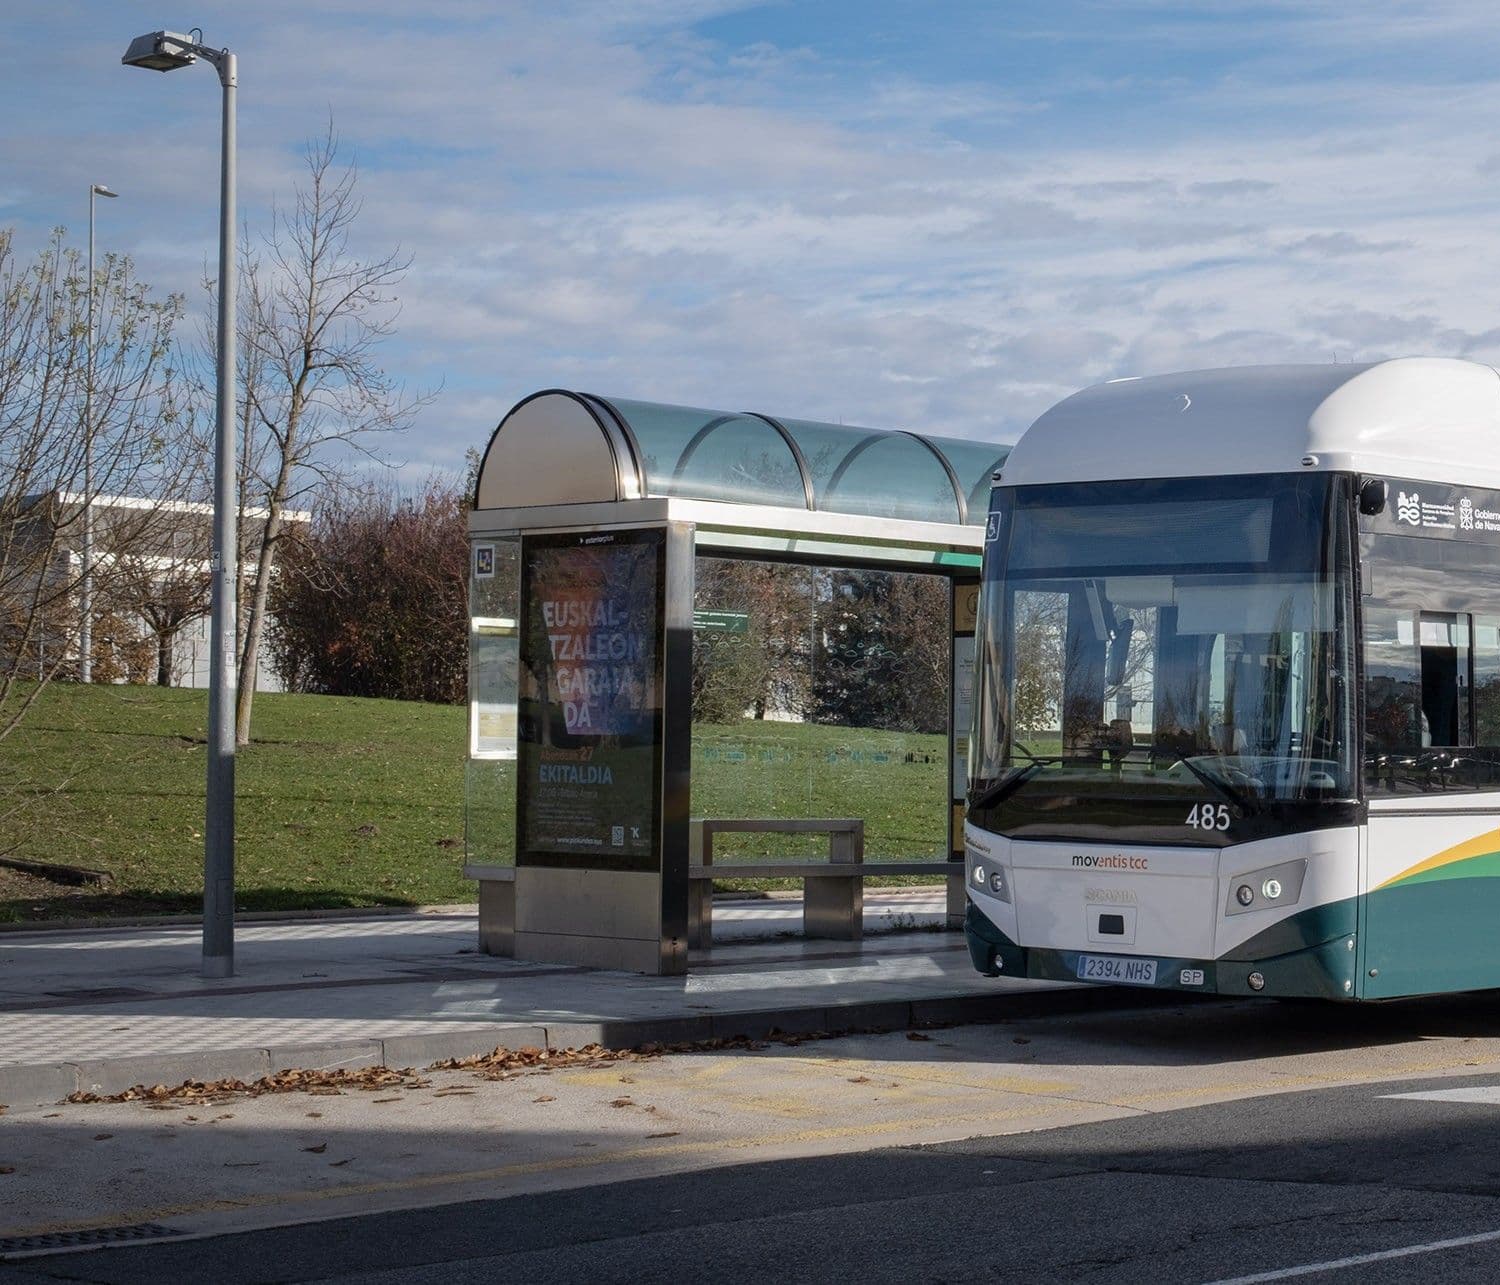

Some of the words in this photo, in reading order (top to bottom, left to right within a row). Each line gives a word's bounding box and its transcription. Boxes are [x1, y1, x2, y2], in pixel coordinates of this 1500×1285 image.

[1475, 521, 1484, 529] de
[543, 600, 629, 627] EUSKAL-
[549, 632, 643, 660] TZALEON
[564, 701, 592, 728] DA
[539, 764, 614, 784] EKITALDIA
[1185, 803, 1230, 830] 485
[1072, 854, 1128, 869] moventis
[1129, 857, 1148, 870] tcc
[1087, 960, 1121, 977] 2394
[1125, 962, 1152, 980] NHS
[1182, 971, 1202, 983] SP
